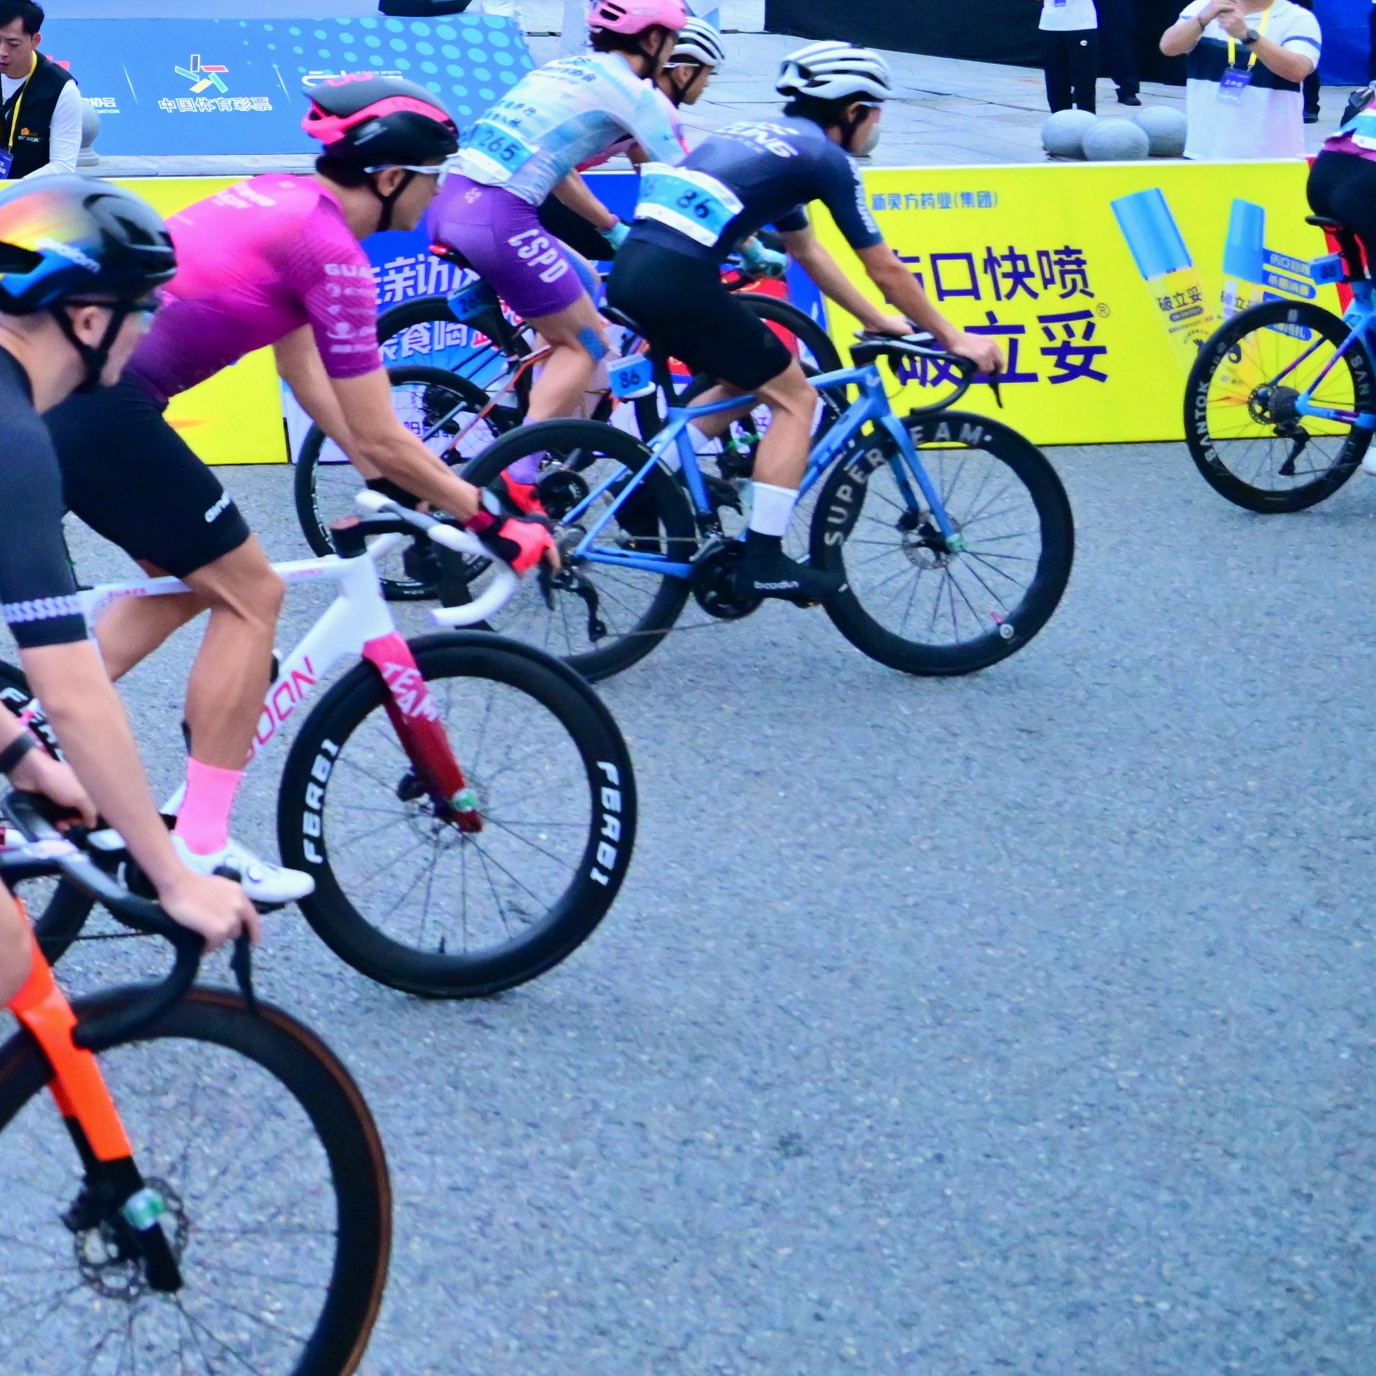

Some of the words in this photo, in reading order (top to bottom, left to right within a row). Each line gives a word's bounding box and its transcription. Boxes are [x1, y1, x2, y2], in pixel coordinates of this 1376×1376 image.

[159, 96, 273, 112] 中国体育彩票
[507, 228, 571, 284] CSPD
